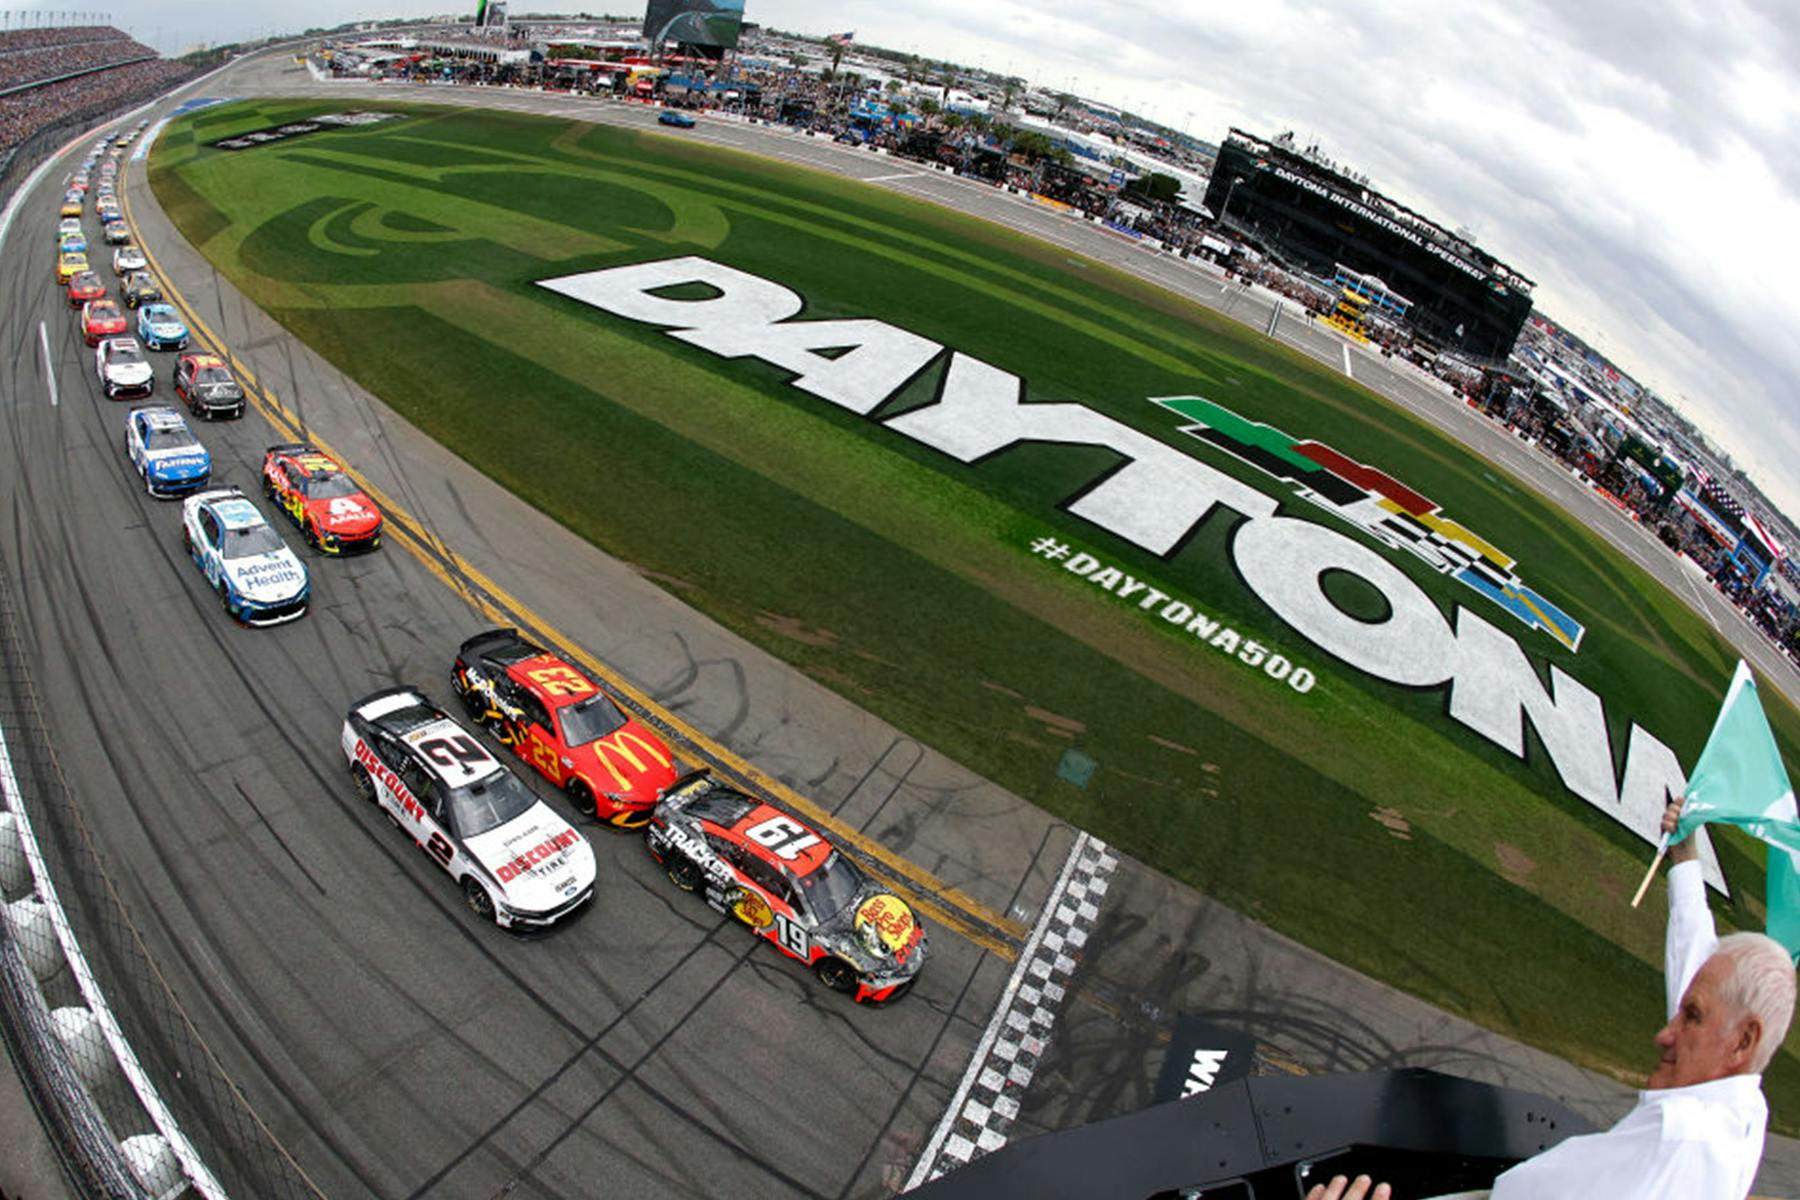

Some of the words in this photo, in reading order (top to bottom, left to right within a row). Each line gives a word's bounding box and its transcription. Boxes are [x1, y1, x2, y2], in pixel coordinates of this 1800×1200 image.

[1274, 167, 1328, 198] DAYTONA
[1330, 193, 1423, 247] INTERNATIONAL
[1426, 242, 1487, 282] SPEEDWAY
[237, 560, 293, 578] Advent
[245, 571, 300, 589] Health
[536, 257, 1729, 897] DAYTONA
[1030, 537, 1316, 694] #DAYTONA500
[528, 667, 594, 694] 23
[419, 735, 492, 767] 2
[530, 734, 562, 781] 23
[355, 738, 425, 823] DISCOUNT
[427, 832, 455, 866] 2
[496, 829, 580, 884] DISCOUNT
[665, 823, 735, 882] TRACKER
[745, 816, 821, 861] 19
[860, 898, 885, 922] Bass
[885, 911, 912, 941] Shops
[775, 913, 809, 960] 19
